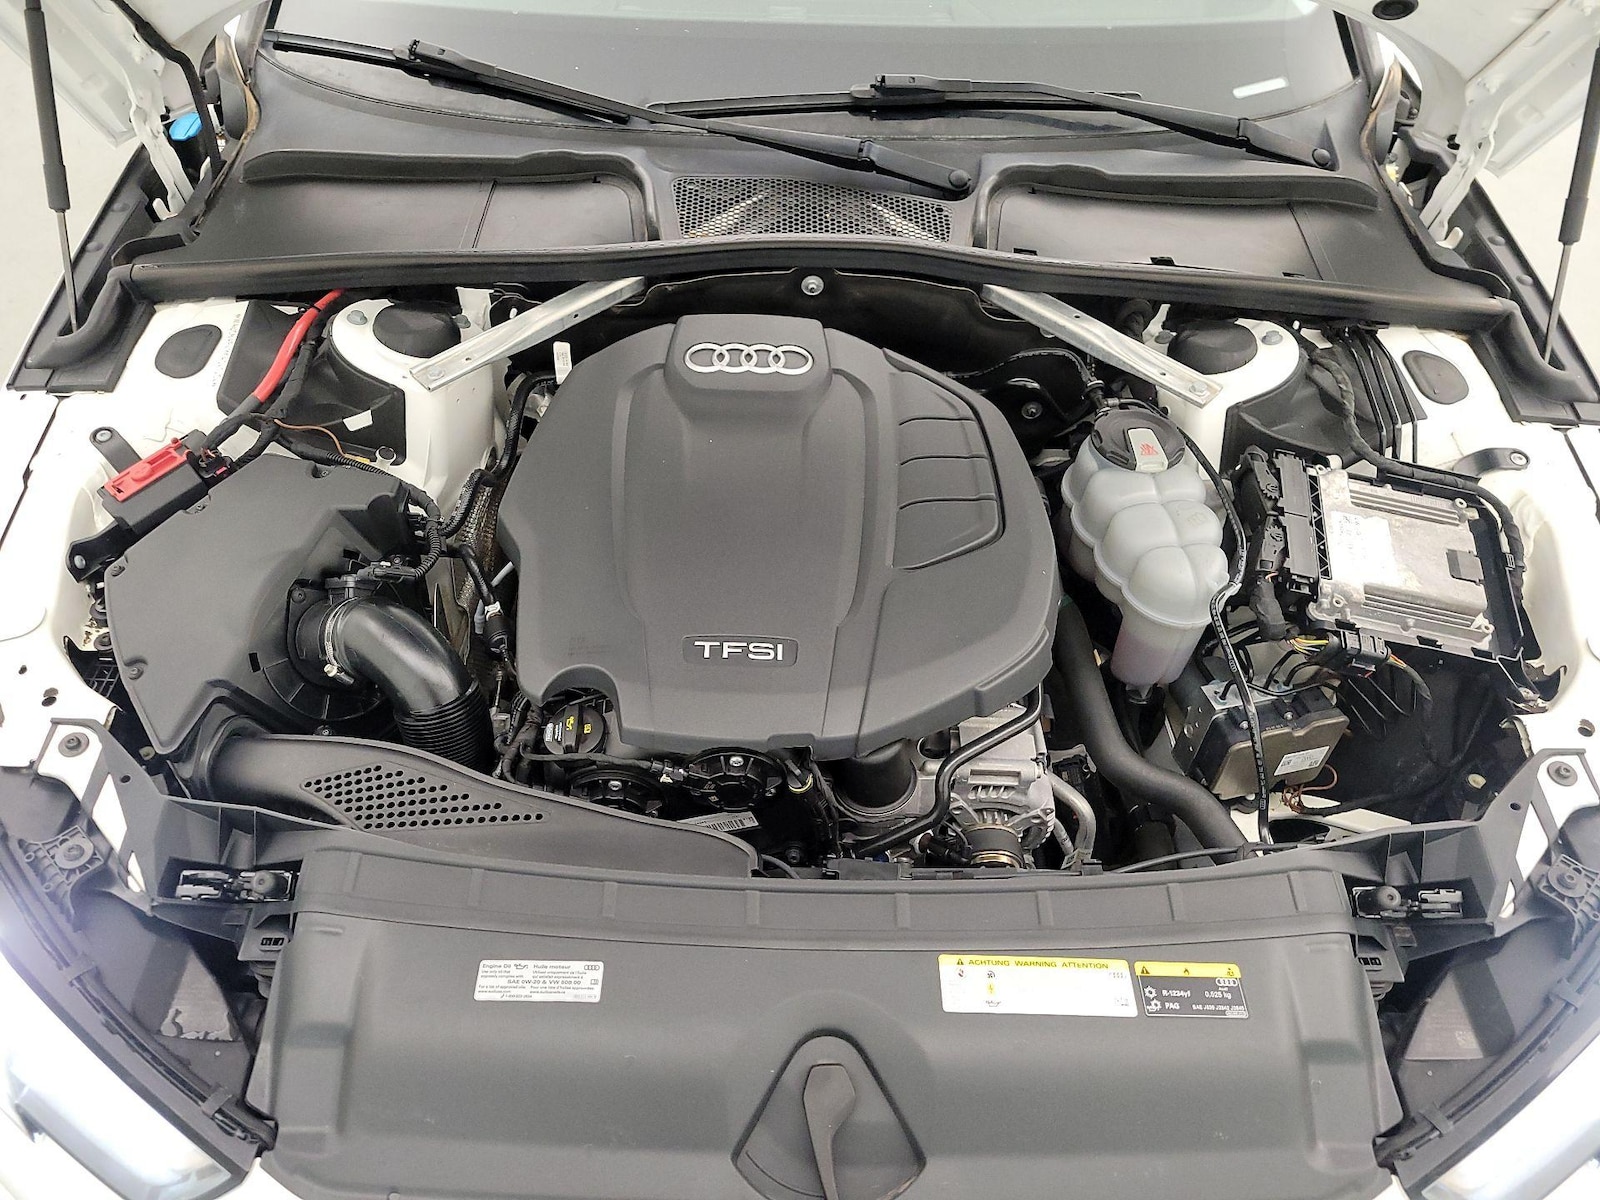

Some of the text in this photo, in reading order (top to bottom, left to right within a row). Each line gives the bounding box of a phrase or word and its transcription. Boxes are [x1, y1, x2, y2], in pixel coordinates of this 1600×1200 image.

[693, 640, 784, 662] TFSI
[968, 958, 1109, 969] ACHTUNG WARNING ATTENTION
[1223, 991, 1232, 1000] kg
[1164, 1002, 1181, 1010] PAG
